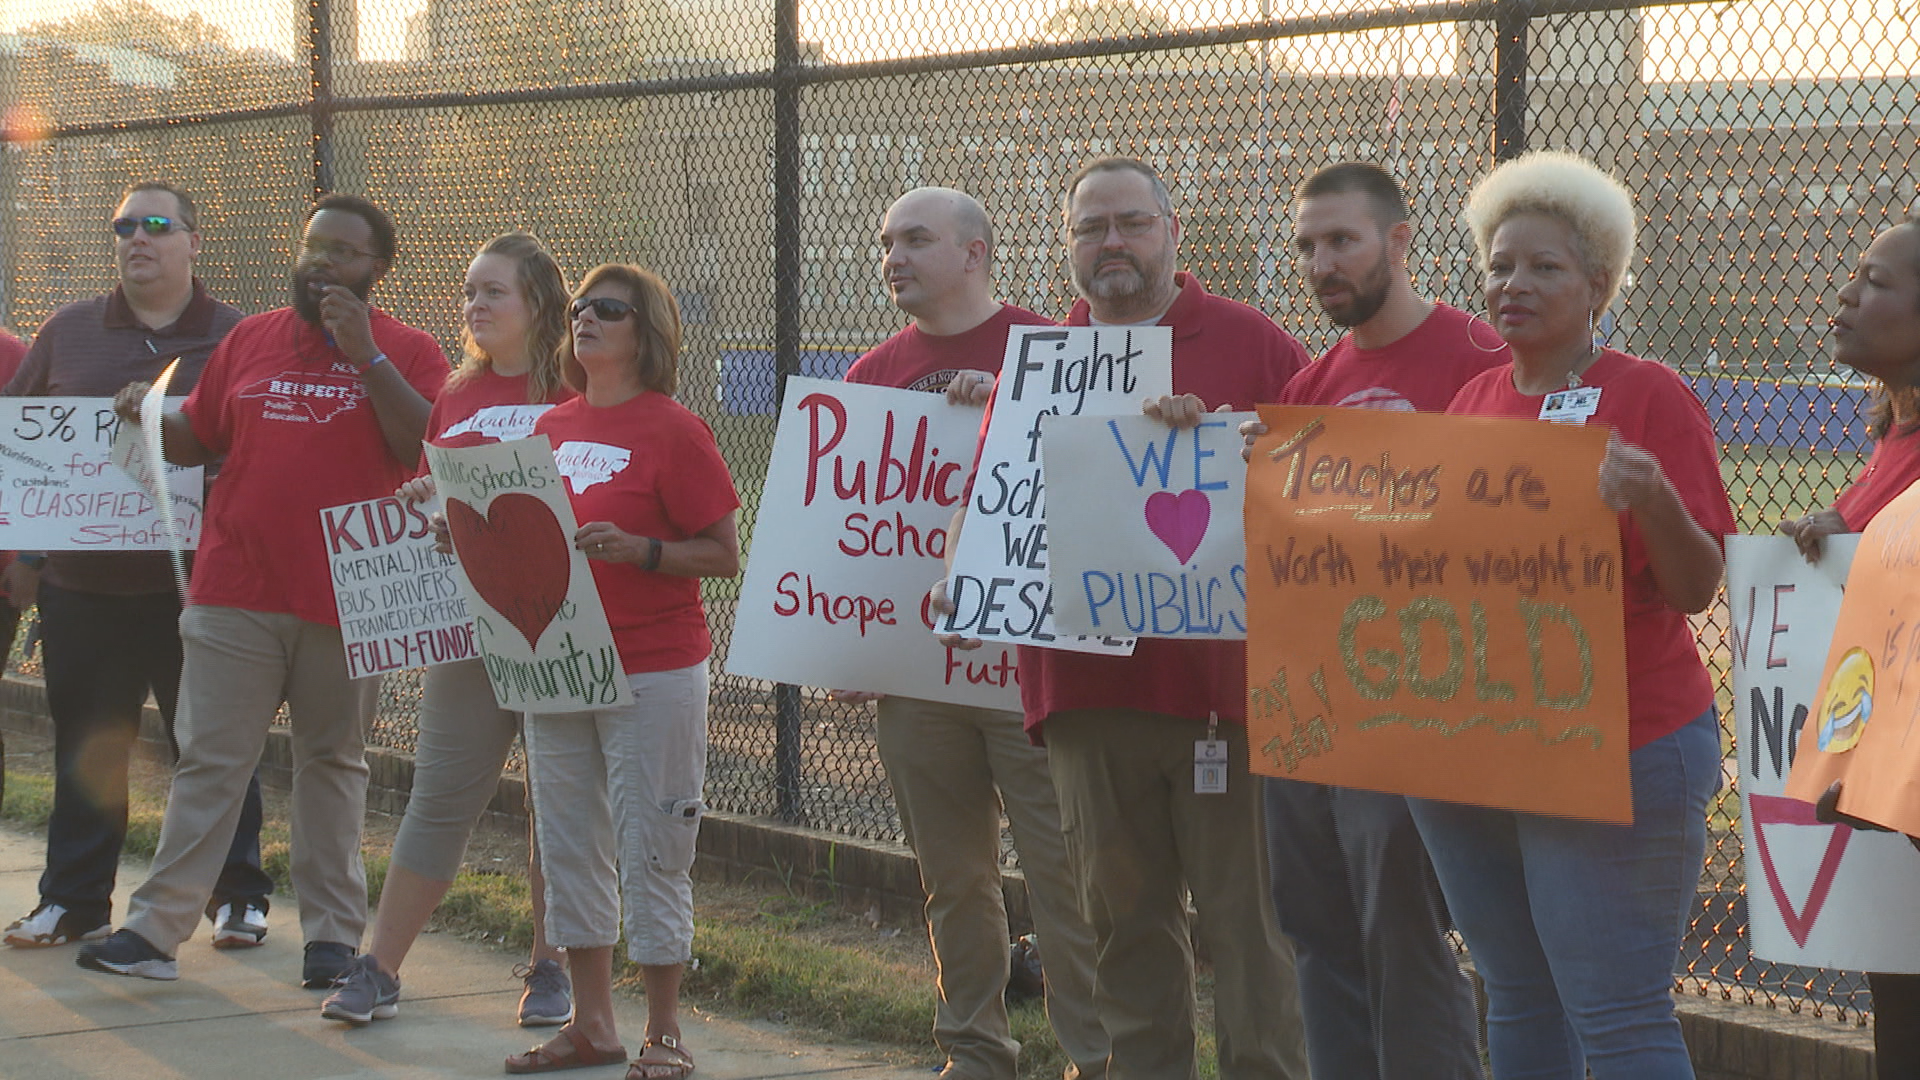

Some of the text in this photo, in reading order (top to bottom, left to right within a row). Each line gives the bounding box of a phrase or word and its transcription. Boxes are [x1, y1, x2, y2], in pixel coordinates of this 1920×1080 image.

[1011, 330, 1143, 415] Fight
[13, 405, 76, 442] 5%
[261, 410, 310, 422] Education
[263, 399, 295, 411] Public
[64, 452, 112, 477] for
[469, 450, 556, 499] Schools:
[797, 392, 962, 507] Public
[1107, 419, 1230, 490] WE
[1268, 415, 1551, 513] Teachers are
[20, 487, 154, 518] CLASSIFIED
[324, 498, 429, 555] KIDS
[333, 545, 418, 587] (MENTAL)
[1002, 522, 1048, 569] WE
[1378, 532, 1449, 590] their
[1463, 535, 1577, 597] weight
[1580, 541, 1616, 592] in
[338, 570, 458, 617] BUS DRIVERS
[347, 621, 479, 678] FULLY-FUNDE
[477, 616, 618, 705] Community
[945, 645, 1021, 688] Fut
[1337, 595, 1594, 711] GOLD
[1250, 665, 1298, 728] PAY
